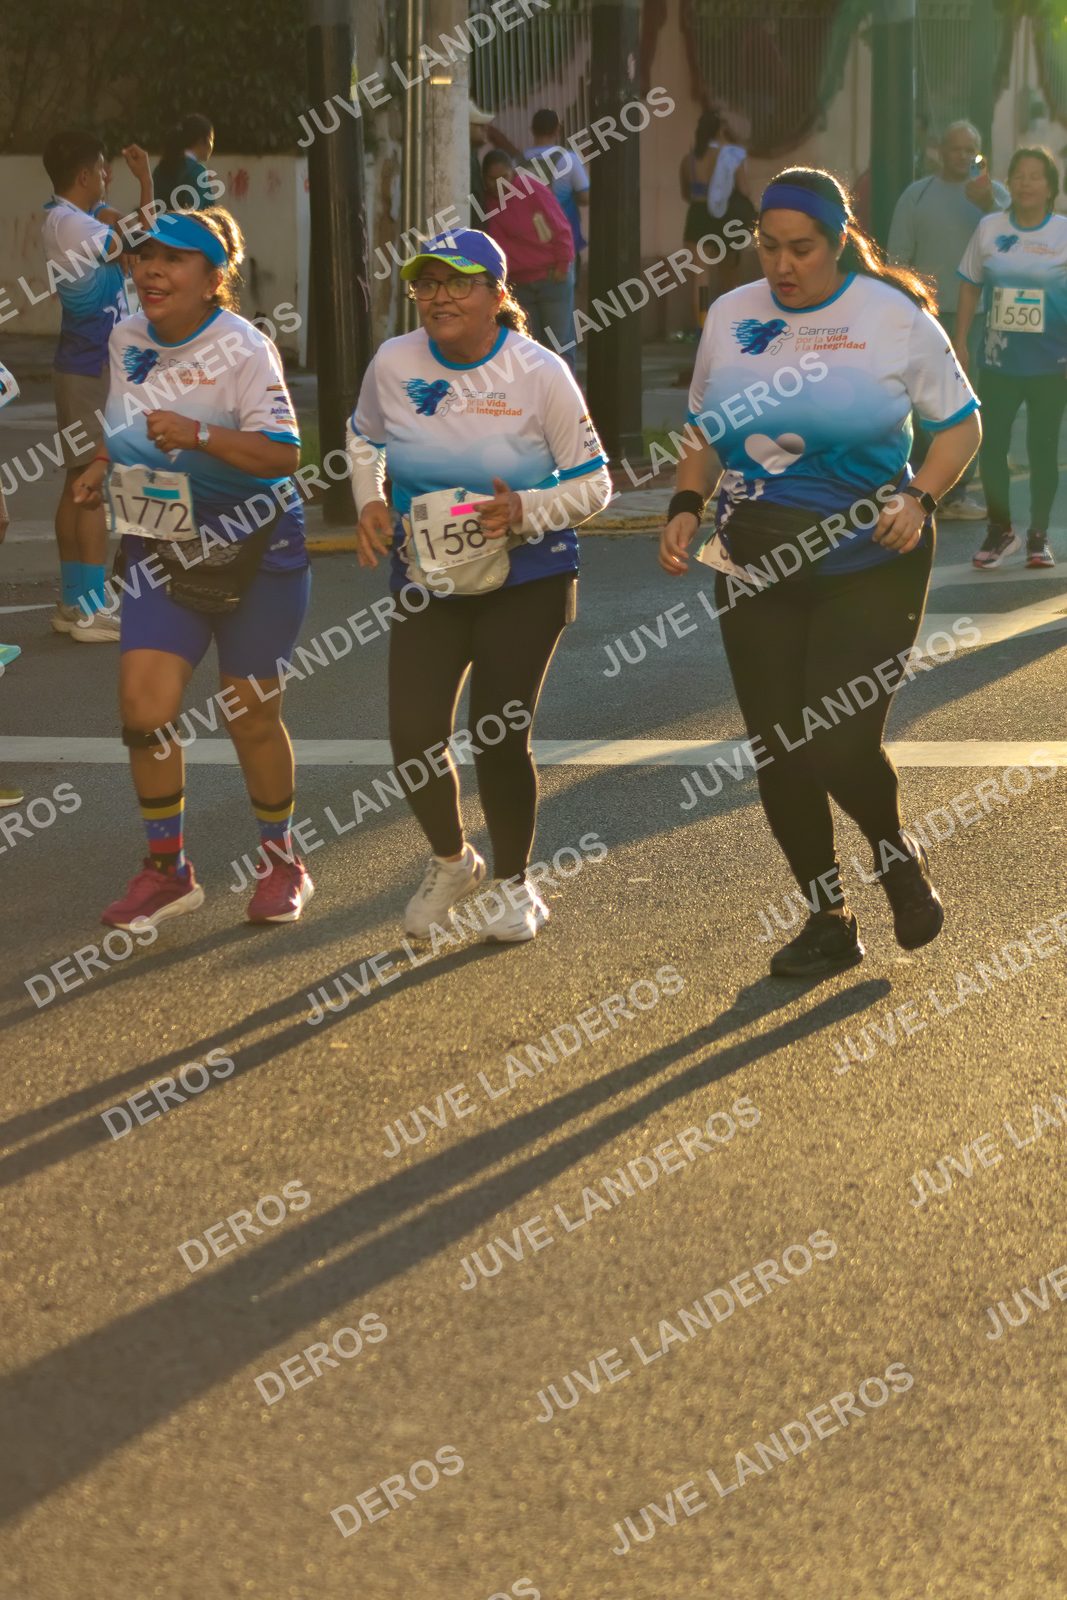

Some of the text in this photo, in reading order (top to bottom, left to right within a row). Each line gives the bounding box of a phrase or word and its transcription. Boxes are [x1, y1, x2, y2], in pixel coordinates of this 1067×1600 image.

[994, 305, 1042, 326] 1550
[798, 326, 849, 336] Carrera
[813, 342, 866, 351] Integridad
[486, 399, 506, 408] Vida
[477, 407, 522, 416] Integridad
[116, 495, 191, 532] 1772
[420, 519, 487, 560] 158
